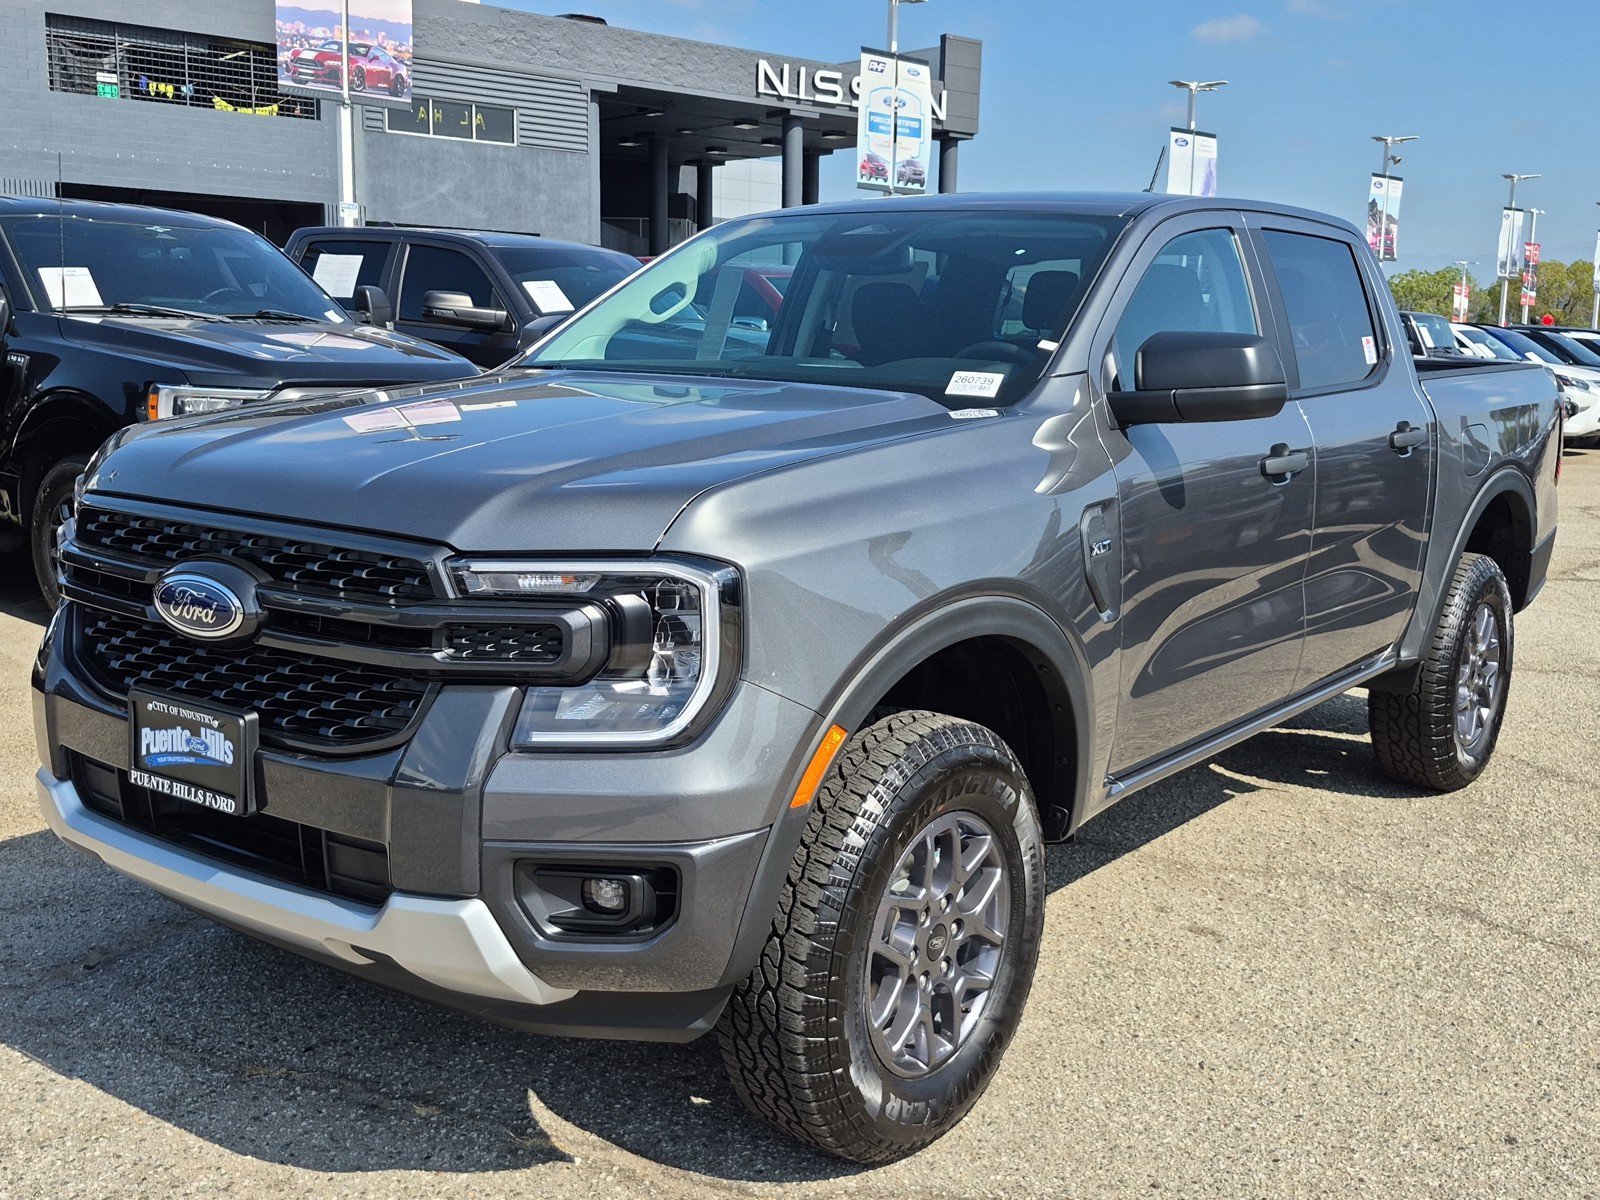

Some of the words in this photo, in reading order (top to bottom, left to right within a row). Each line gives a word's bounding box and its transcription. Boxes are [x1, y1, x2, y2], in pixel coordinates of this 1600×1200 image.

[758, 59, 947, 120] NISN
[954, 376, 994, 386] 260739
[1090, 539, 1112, 557] XLT
[170, 587, 216, 624] Ford
[152, 700, 168, 713] CITY
[169, 705, 179, 716] OF
[179, 708, 215, 725] INDUSTRY
[141, 726, 191, 756] Puente
[201, 727, 233, 765] Hills
[130, 769, 171, 793] PUENTE
[171, 781, 204, 805] HILLS
[205, 791, 235, 813] FORD
[898, 772, 1017, 841] WRANGLER
